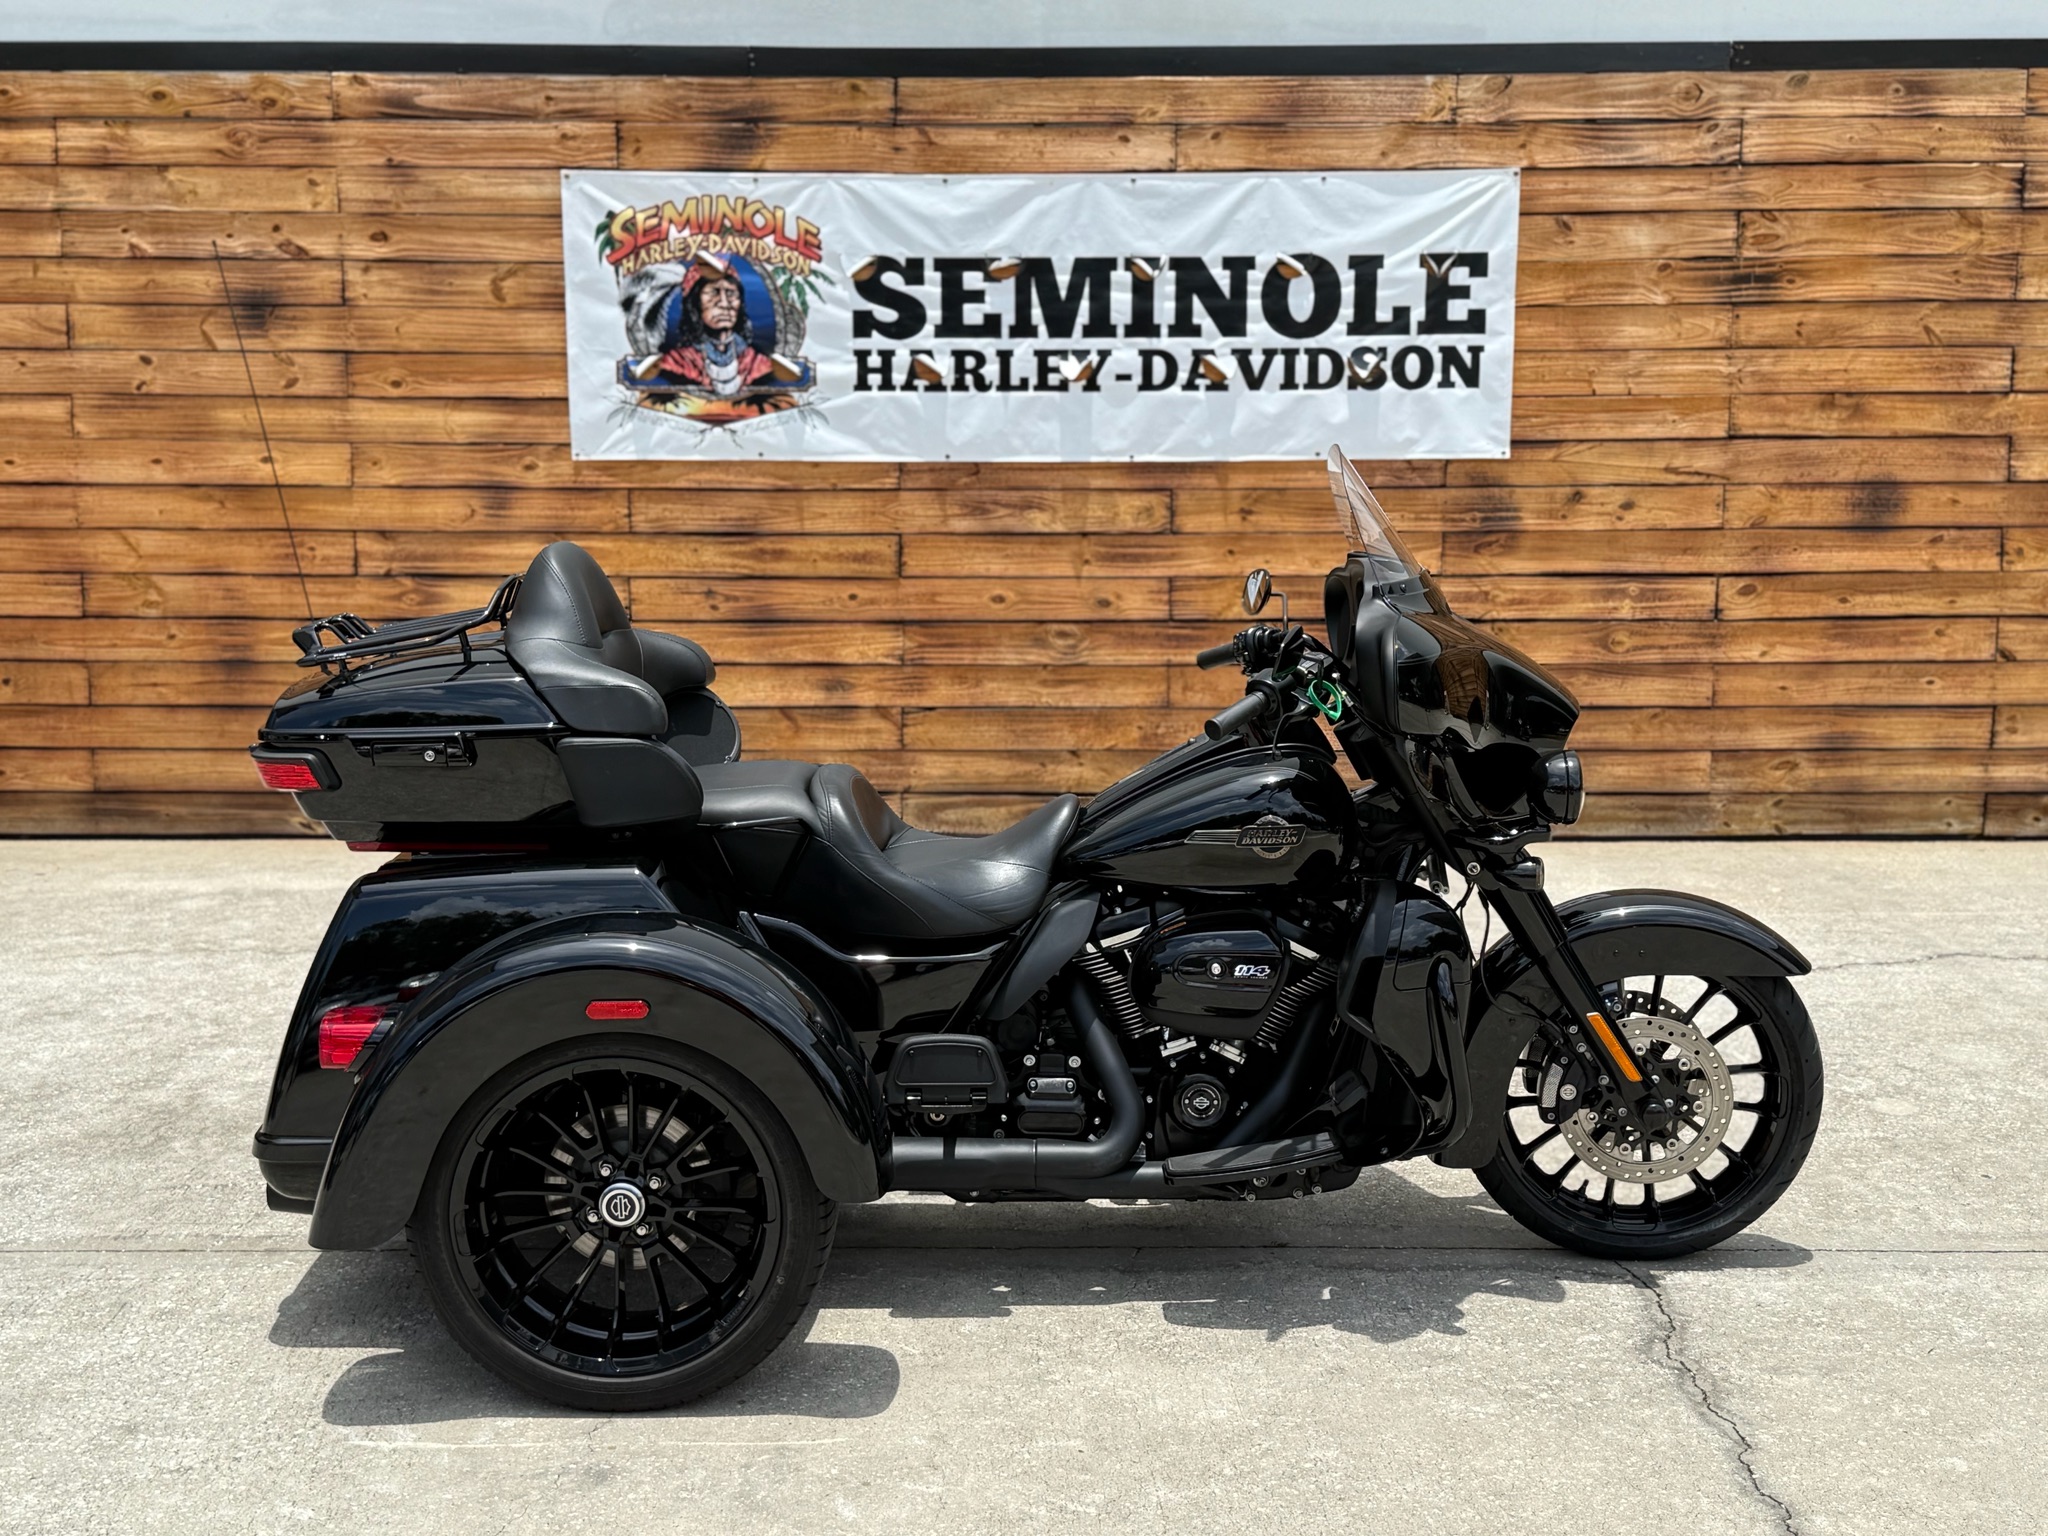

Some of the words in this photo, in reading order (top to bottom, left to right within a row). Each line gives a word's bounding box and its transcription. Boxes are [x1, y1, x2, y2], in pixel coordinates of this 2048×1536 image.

[606, 195, 822, 264] SEMINOLE
[622, 233, 812, 277] HARLEY-DAVIDSON
[852, 252, 1489, 340] SEMINOLE
[853, 345, 1485, 392] HARLEY-DAVIDSON
[1241, 836, 1299, 845] DAVIDSON
[1234, 964, 1272, 976] 114
